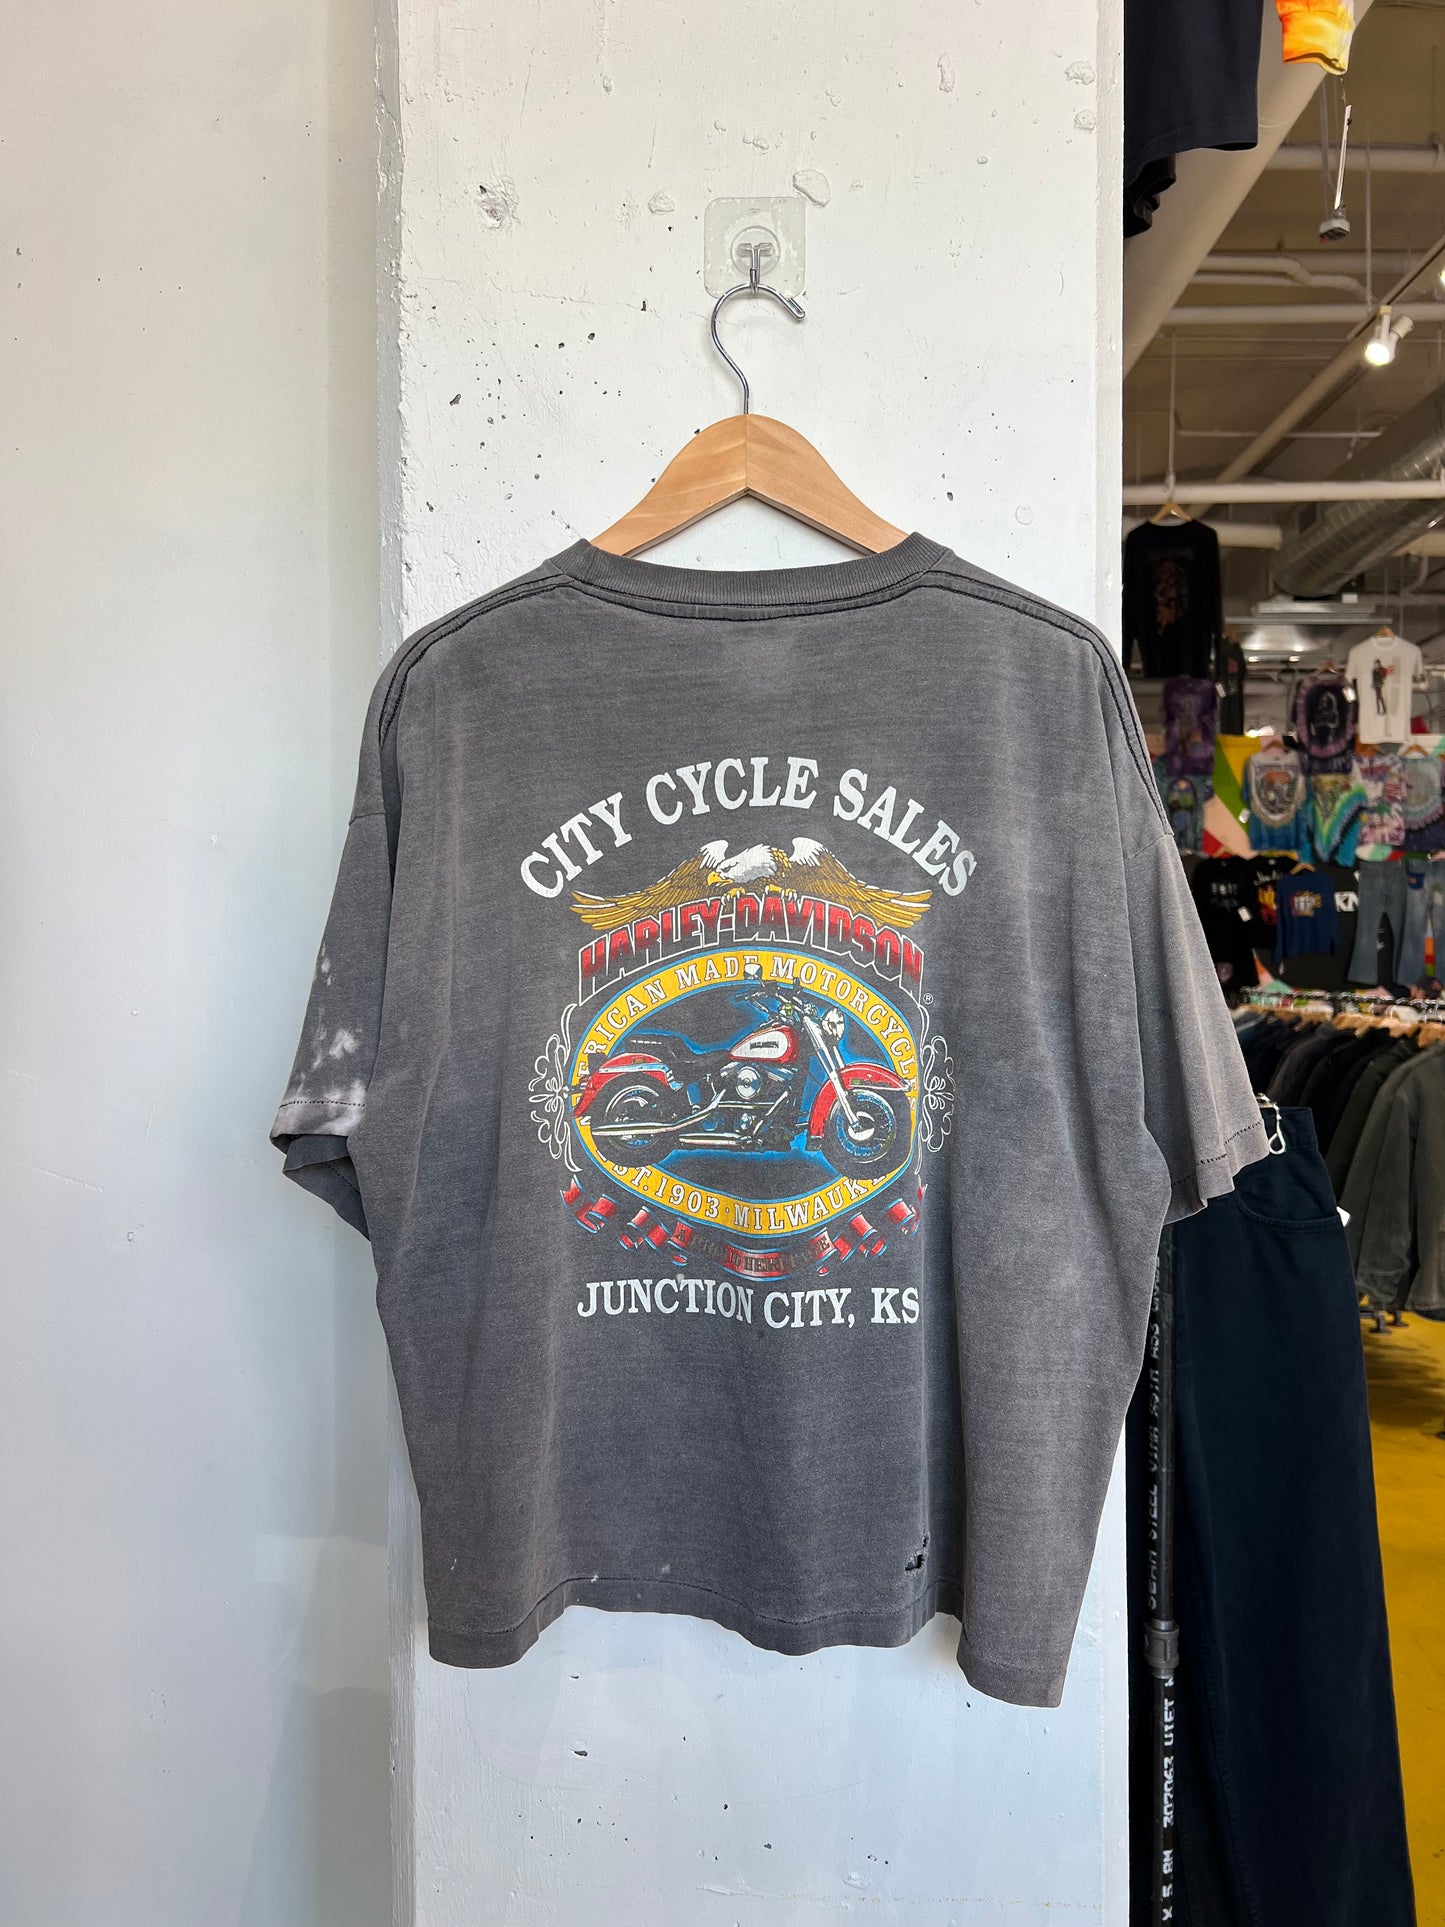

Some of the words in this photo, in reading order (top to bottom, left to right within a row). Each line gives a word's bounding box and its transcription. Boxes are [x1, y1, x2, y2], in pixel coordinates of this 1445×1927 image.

[519, 792, 633, 898] CITY
[645, 756, 820, 826] CYCLE
[832, 769, 978, 897] SALES
[579, 893, 924, 1005] HARLEY-DAVIDSON
[576, 980, 667, 1126] ERICAN
[655, 1178, 720, 1223] 1903
[734, 1174, 886, 1231] MILWAUK
[576, 1278, 754, 1324] JUNCTION
[763, 1287, 856, 1329] CITY,
[870, 1286, 921, 1324] KS
